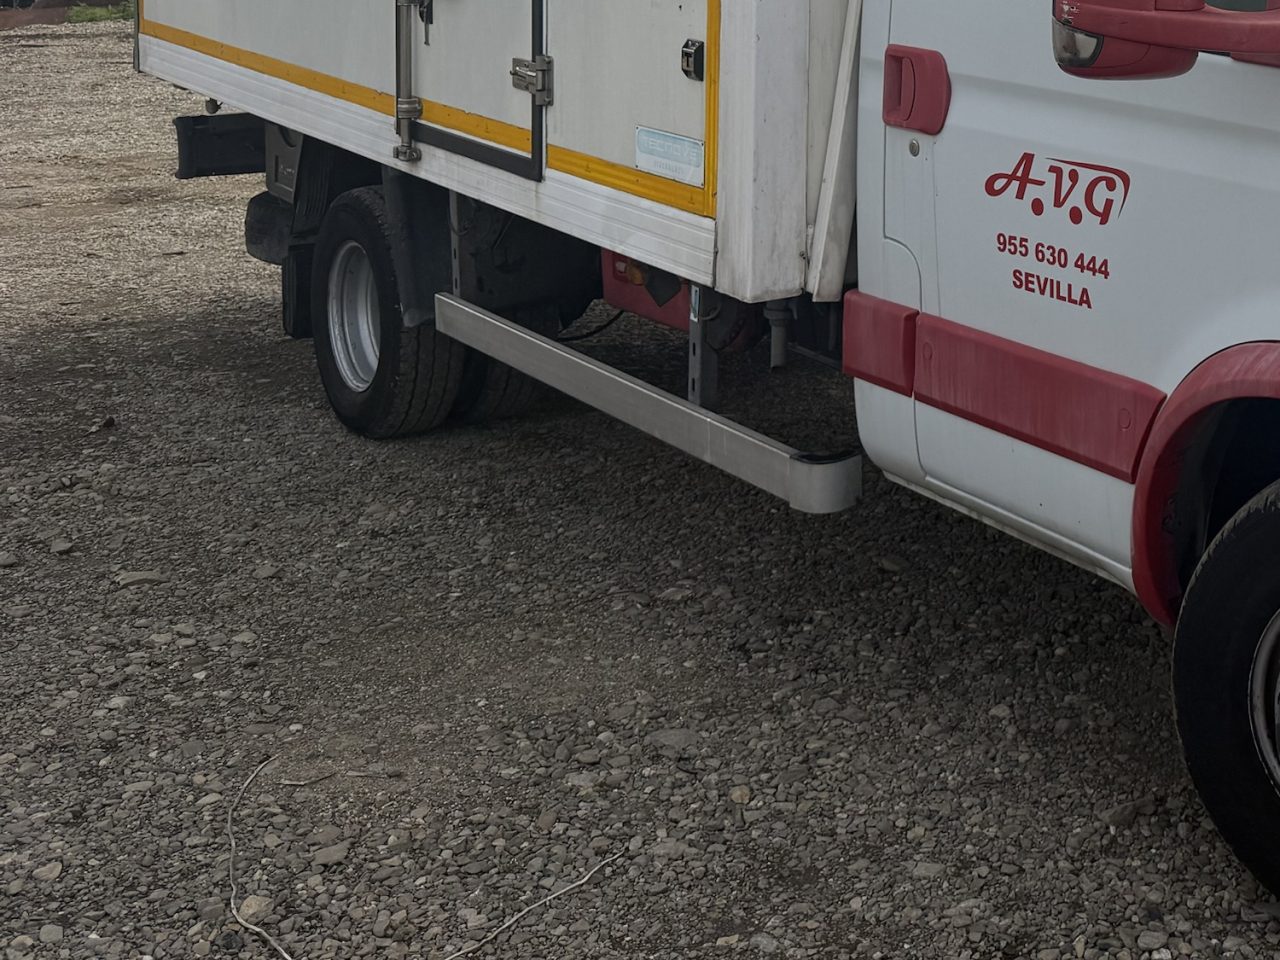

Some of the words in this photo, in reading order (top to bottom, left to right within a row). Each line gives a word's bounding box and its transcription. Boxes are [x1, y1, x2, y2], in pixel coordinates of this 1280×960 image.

[996, 232, 1029, 257] 955
[1035, 242, 1068, 269] 630
[1074, 252, 1110, 280] 444
[1012, 268, 1093, 309] SEVILLA
